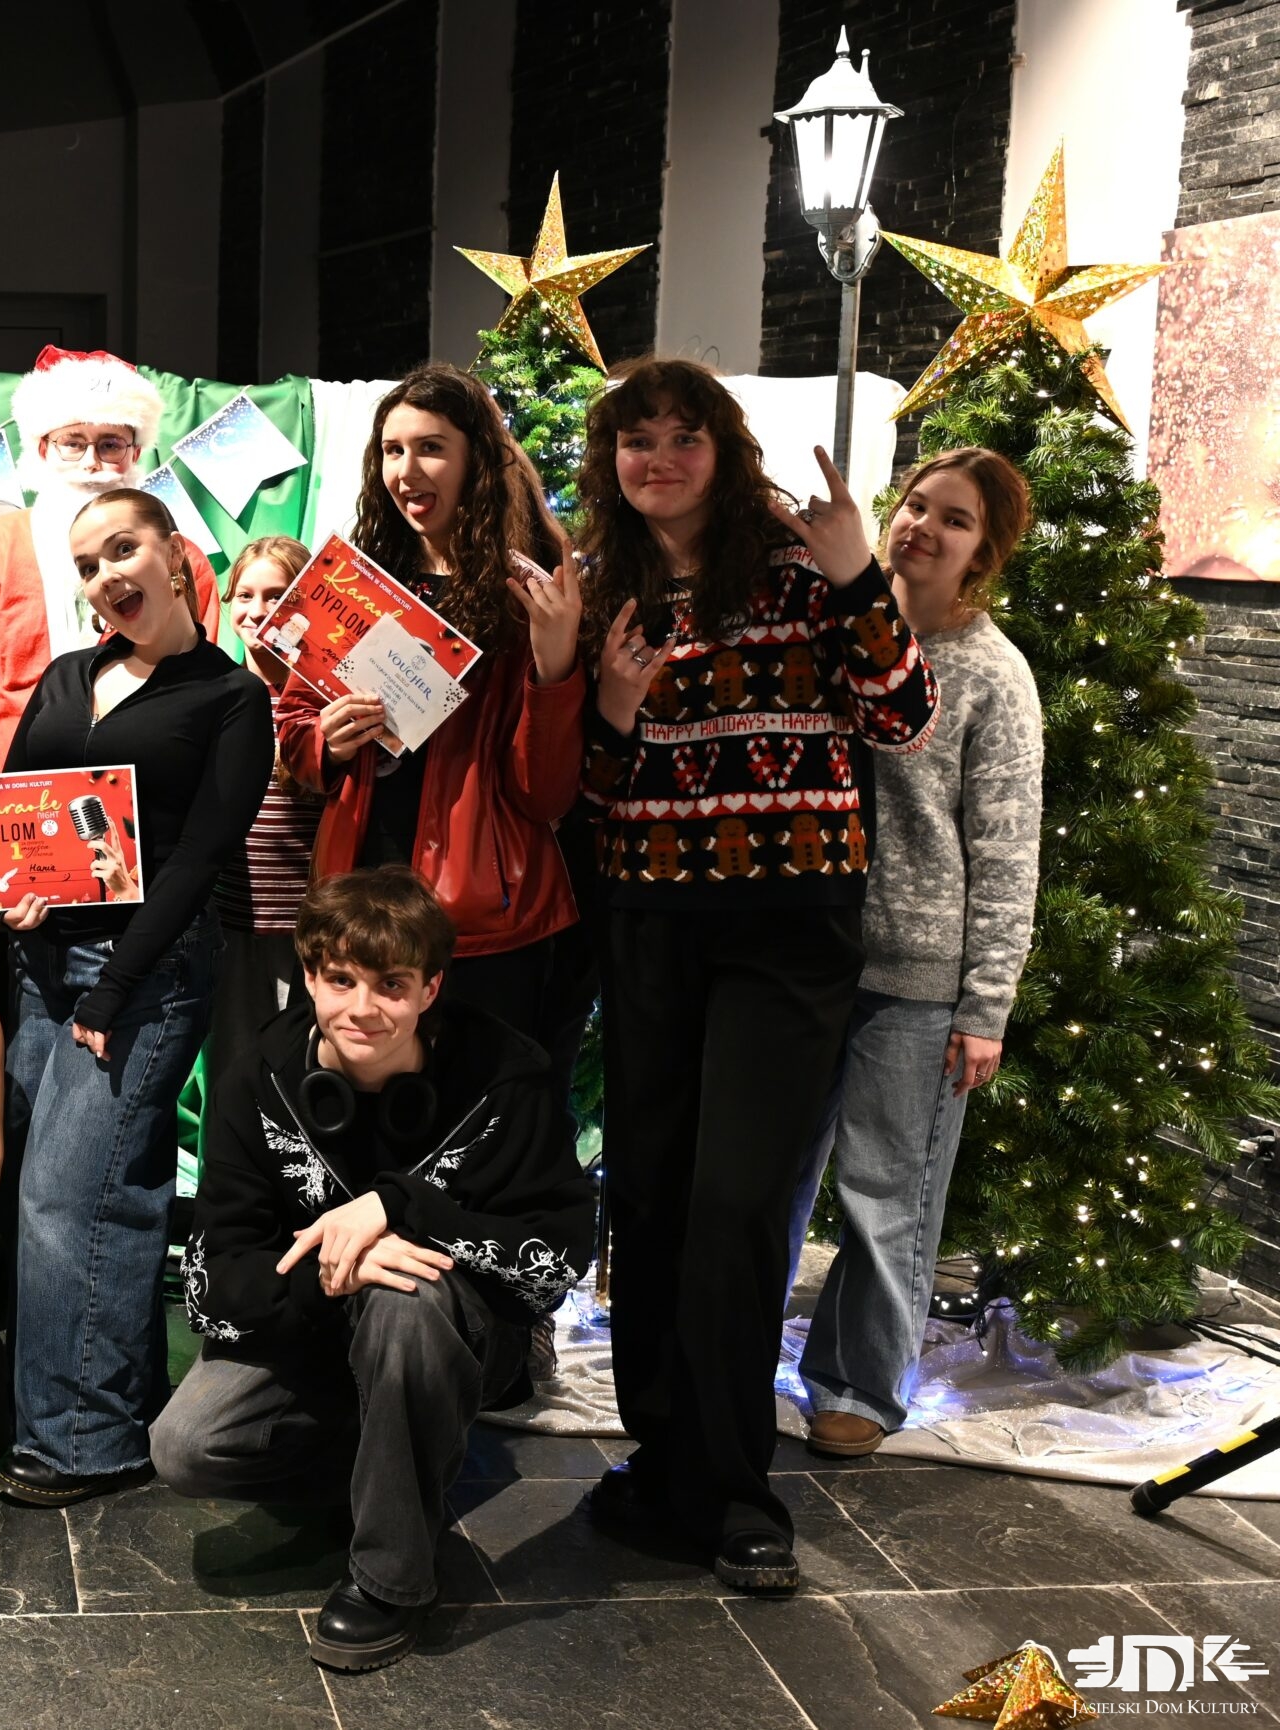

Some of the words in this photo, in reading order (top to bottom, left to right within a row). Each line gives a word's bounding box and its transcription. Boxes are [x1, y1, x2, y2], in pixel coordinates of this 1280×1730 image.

[309, 584, 372, 639] DYPLOM
[326, 625, 346, 645] 2
[387, 650, 432, 701] VOUCHER
[645, 722, 695, 740] HAPPY
[700, 713, 766, 735] HOLIDAYS
[782, 713, 829, 732] HAPPY
[10, 841, 24, 860] 1
